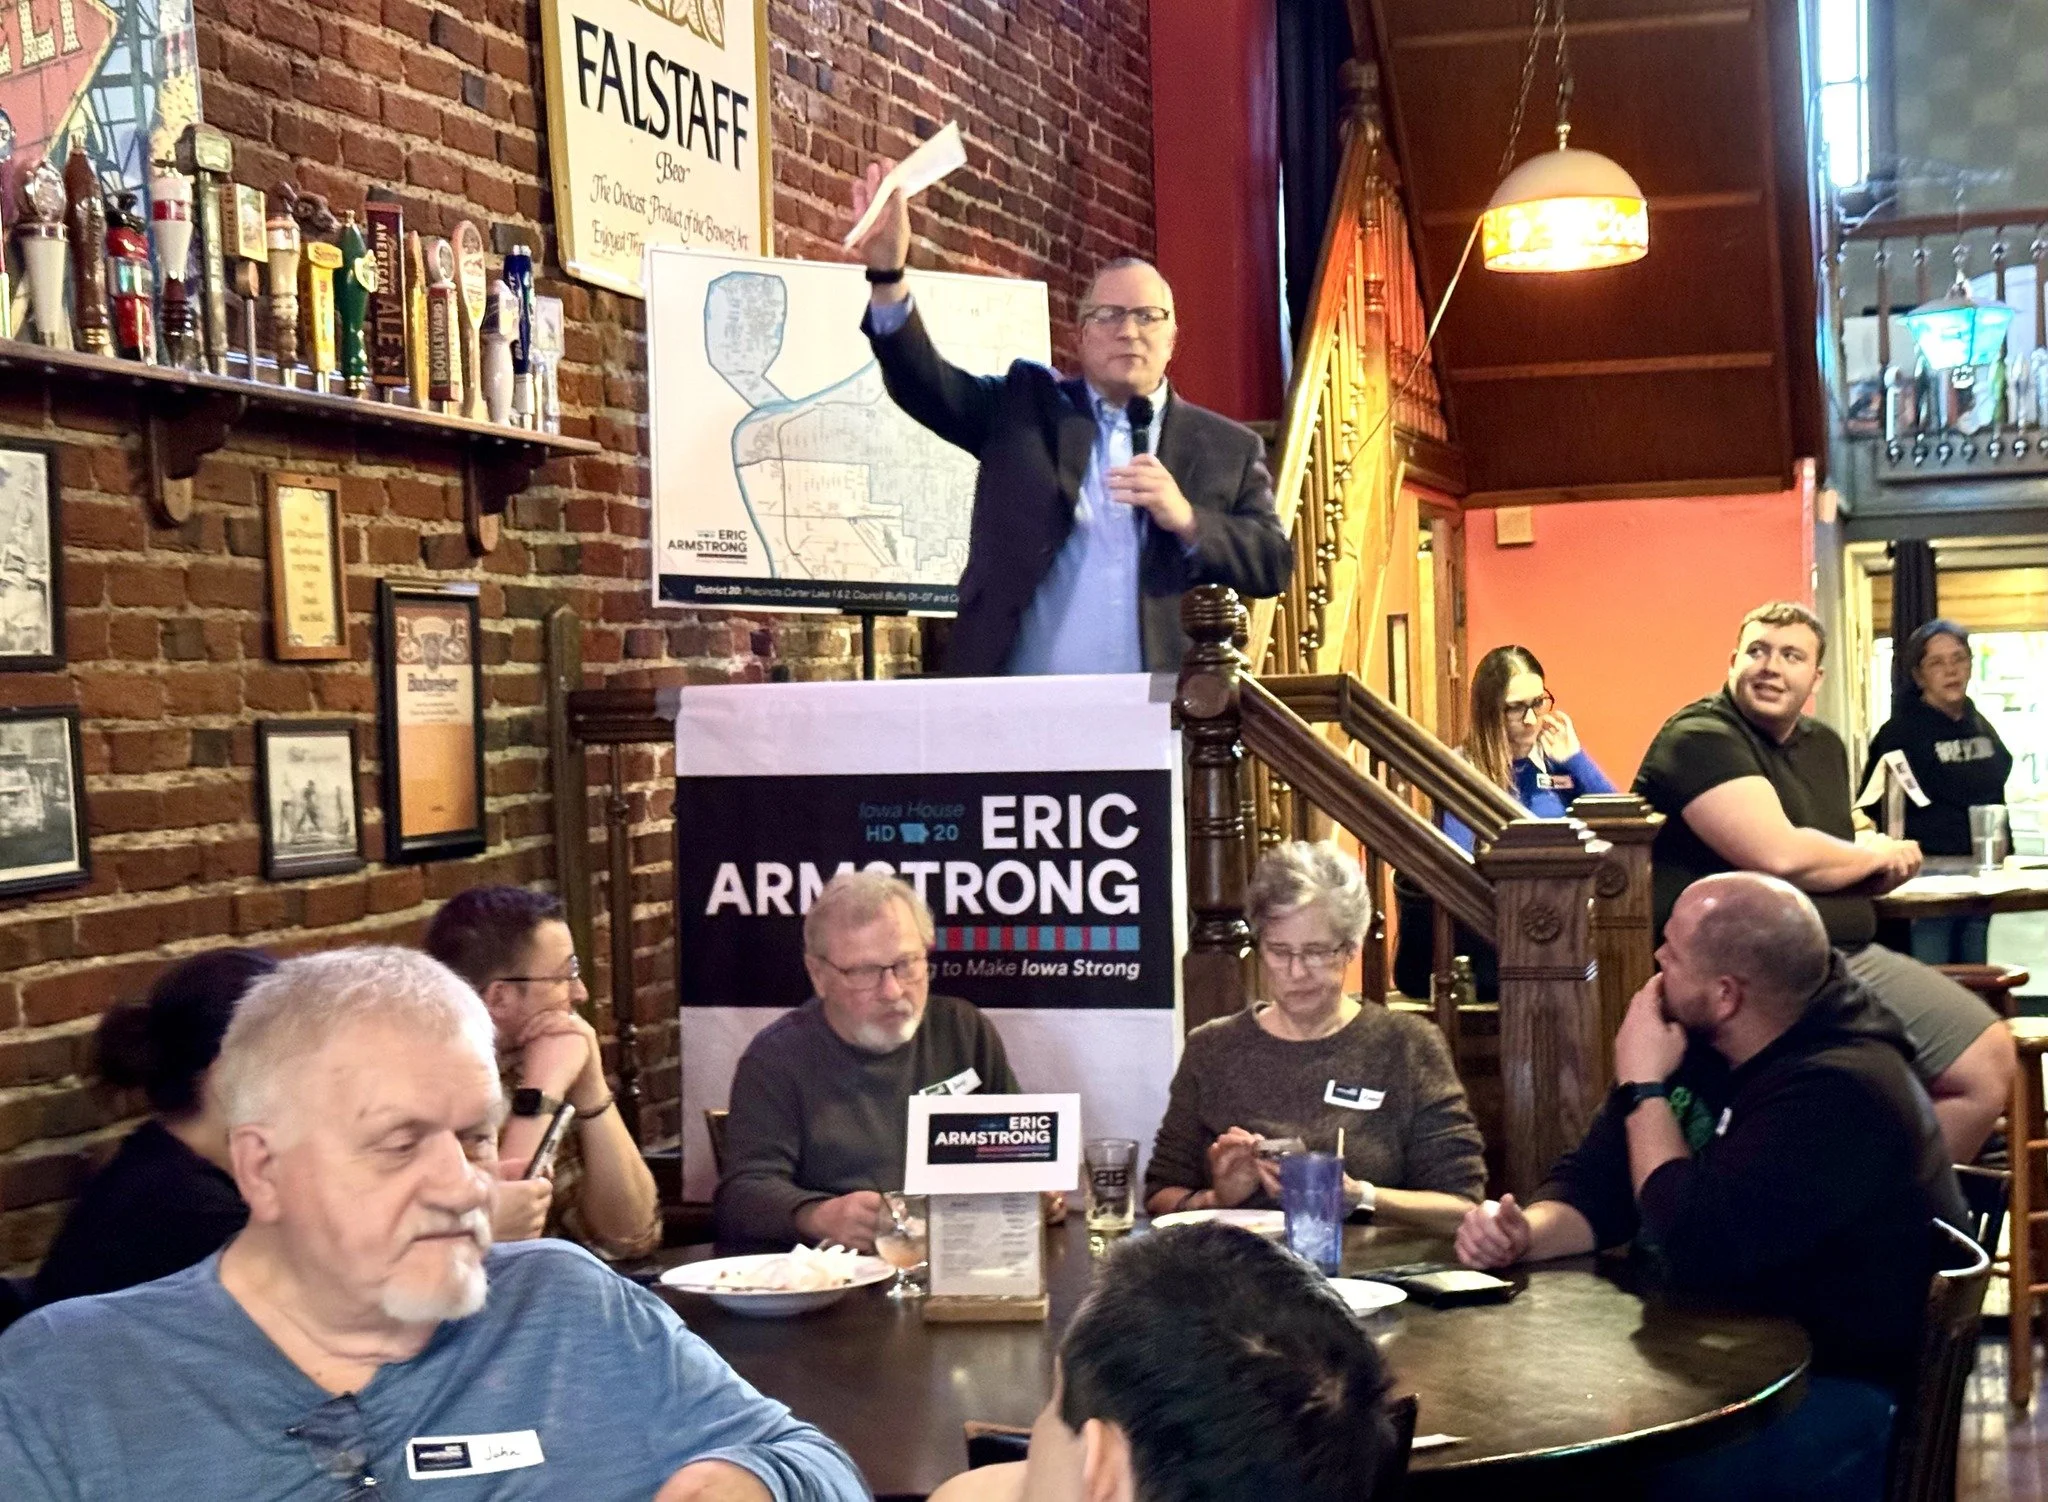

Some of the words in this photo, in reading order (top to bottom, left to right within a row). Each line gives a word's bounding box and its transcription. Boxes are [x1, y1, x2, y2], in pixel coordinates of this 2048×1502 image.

[572, 14, 749, 171] FALSTAFF
[656, 151, 691, 184] Beer
[590, 174, 611, 203] The
[614, 181, 646, 215] Choicest
[647, 195, 682, 228] Product
[681, 209, 694, 243] of
[693, 213, 705, 236] the
[592, 219, 626, 256] Enjoyed
[376, 222, 389, 294] AMERICAN
[376, 299, 401, 346] ALE
[432, 301, 447, 382] BOULEVARD
[667, 539, 748, 553] ARMSTRONG
[718, 529, 748, 541] ERIC
[695, 584, 727, 595] District
[783, 587, 811, 599] Carter
[812, 588, 831, 599] Lake
[853, 589, 884, 601] Council
[885, 590, 907, 602] Bluffs
[860, 802, 902, 818] Iowa
[906, 800, 966, 818] House
[982, 793, 1140, 850] ERIC
[866, 824, 896, 841] HD
[932, 824, 959, 841] 20
[705, 858, 1140, 915] ARMTRONG
[942, 962, 962, 977] to
[966, 959, 1018, 977] Make
[1020, 958, 1068, 977] Iowa
[1073, 958, 1140, 981] Strong
[1008, 1116, 1052, 1130] ERIC
[934, 1130, 1052, 1146] ARMSTRONG
[484, 1442, 521, 1461] John
